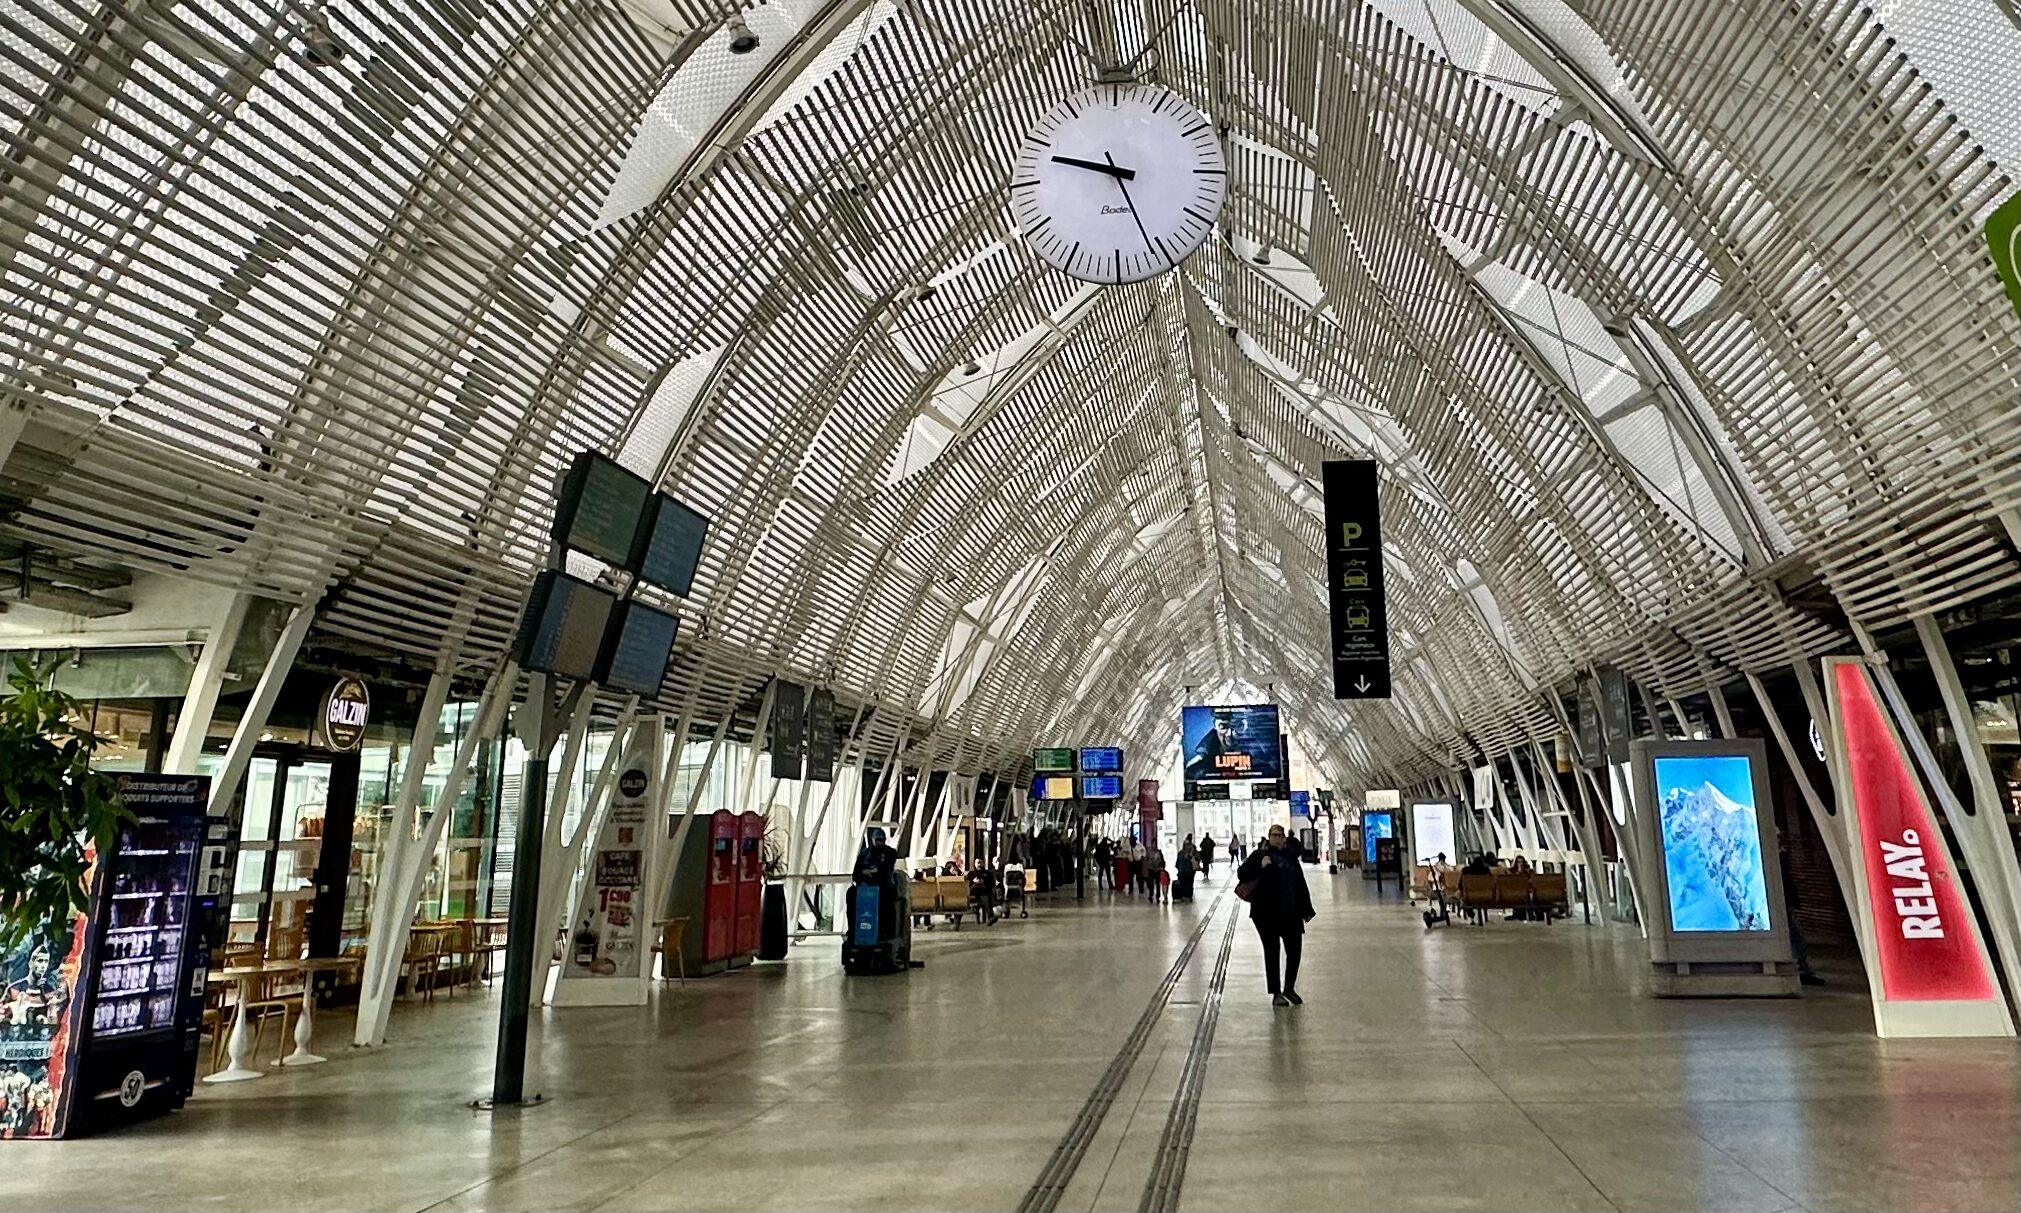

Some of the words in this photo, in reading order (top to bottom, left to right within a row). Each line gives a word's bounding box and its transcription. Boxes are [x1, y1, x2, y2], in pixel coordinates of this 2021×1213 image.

[1101, 205, 1132, 214] Bode
[1343, 523, 1362, 547] P
[329, 698, 368, 727] GALZIN
[1215, 755, 1251, 768] LUPIN
[150, 794, 195, 803] SUPPORTERS
[124, 1079, 140, 1100] 50
